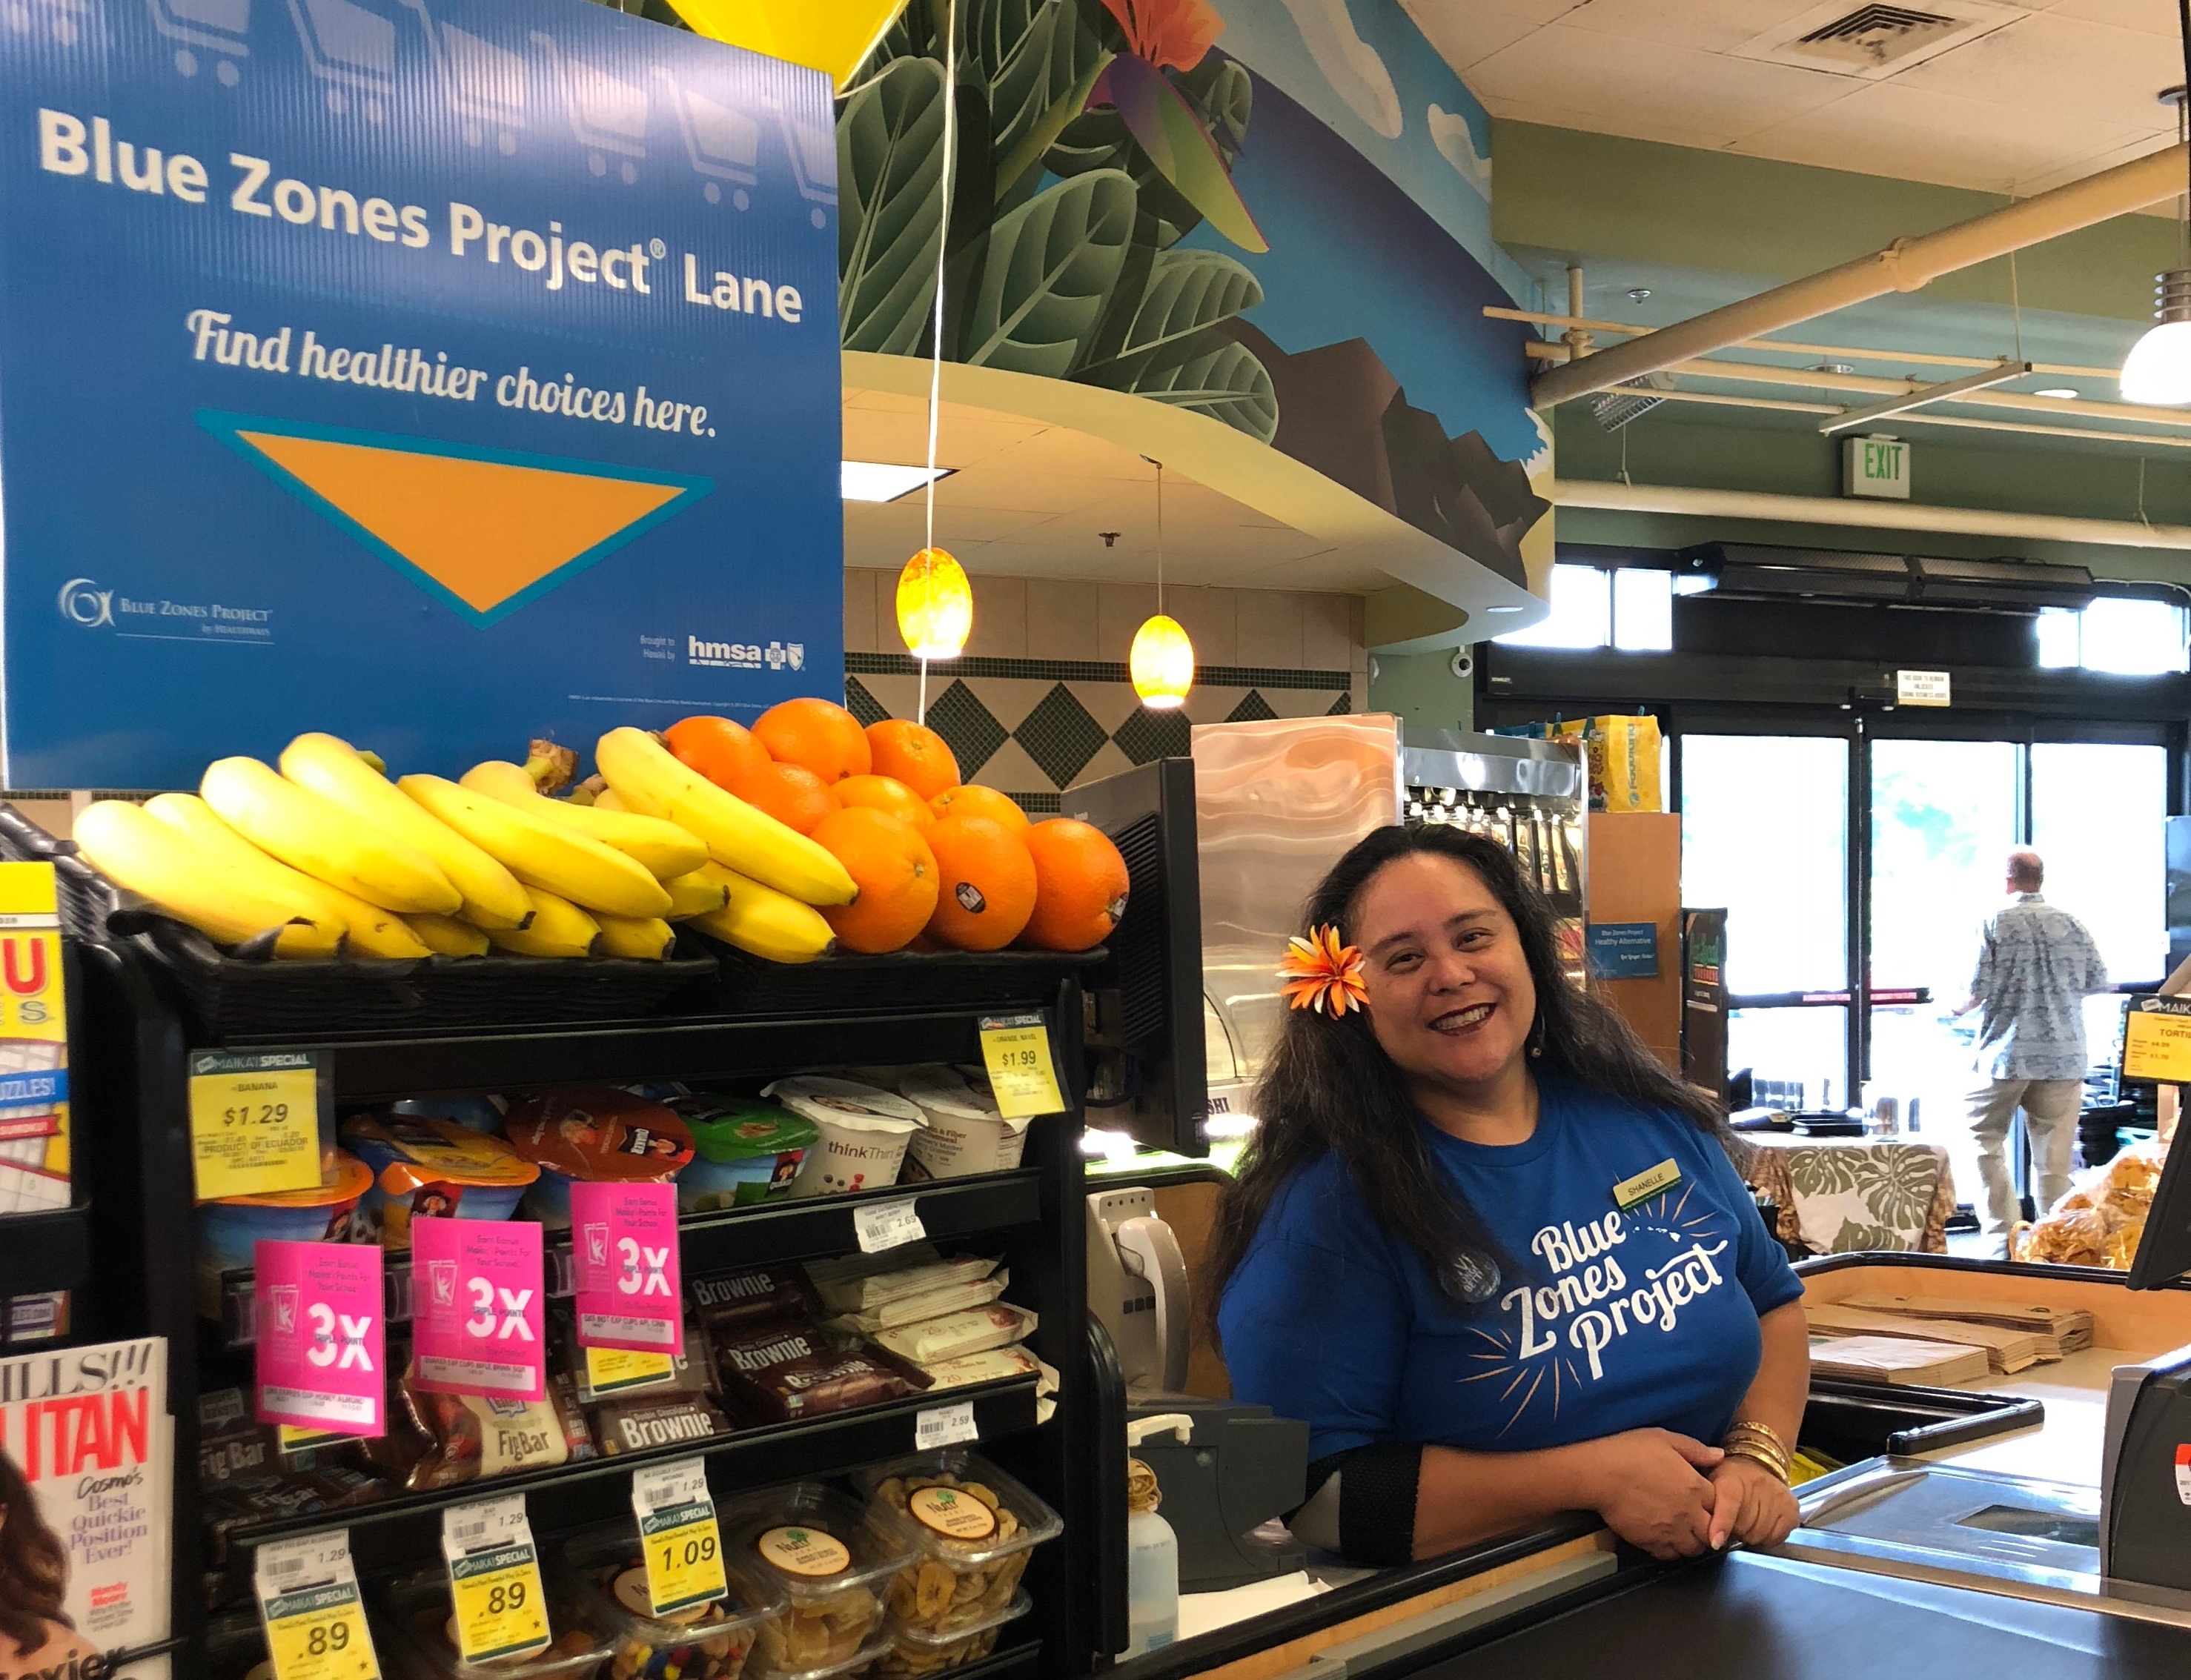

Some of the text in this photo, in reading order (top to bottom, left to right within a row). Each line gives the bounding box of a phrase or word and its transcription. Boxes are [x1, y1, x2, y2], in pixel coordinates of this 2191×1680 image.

[39, 108, 208, 202] Blue
[229, 154, 430, 248] Zones
[684, 253, 803, 323] Lane
[187, 309, 716, 439] Find healthier choices here.
[1865, 443, 1902, 480] EXIT
[120, 598, 270, 622] BLUE ZONES PROJECT
[689, 635, 761, 661] hmsa
[260, 1054, 310, 1066] SPECIAL
[1002, 1050, 1036, 1066] $1.99
[223, 1103, 288, 1127] $1.29
[1628, 1173, 1664, 1196] SHANELLE
[1531, 1210, 1626, 1273] Blue
[693, 1270, 775, 1307] Brownie
[1501, 1255, 1626, 1361] Zones
[1568, 1240, 1728, 1381] Project
[729, 1335, 812, 1371] Brownie
[620, 1410, 715, 1448] Brownie
[684, 1478, 704, 1491] 1.29
[89, 1493, 128, 1511] Best
[680, 1506, 712, 1522] SPECIAL
[73, 1507, 145, 1533] Quickie
[500, 1513, 523, 1527] 1.29
[70, 1525, 147, 1551] Position
[85, 1540, 132, 1564] Ever!
[319, 1548, 345, 1563] 1.29
[495, 1549, 531, 1566] SPECIAL
[663, 1536, 716, 1572] 1.09
[314, 1587, 354, 1606] SPECIAL
[479, 1581, 526, 1618] .89
[299, 1621, 350, 1658] .89
